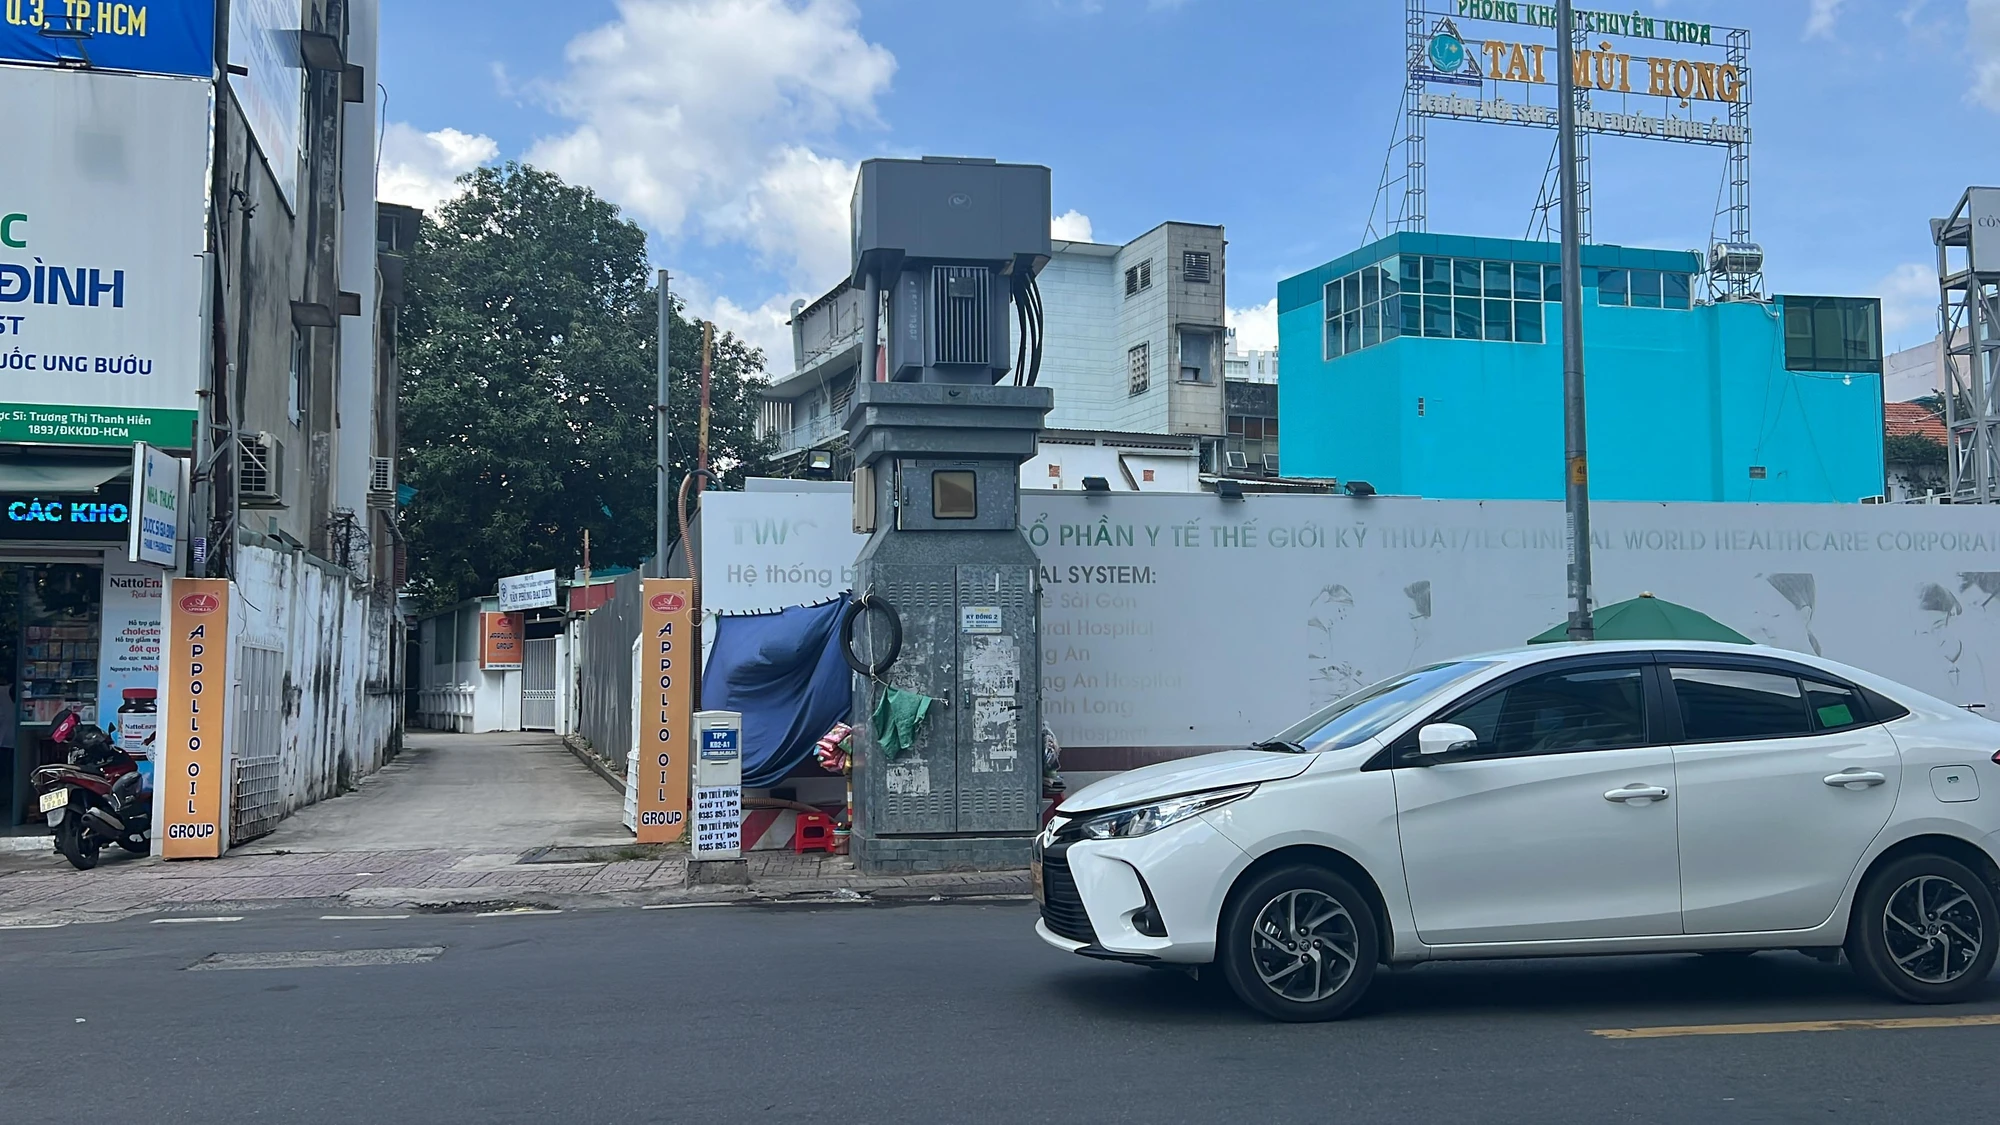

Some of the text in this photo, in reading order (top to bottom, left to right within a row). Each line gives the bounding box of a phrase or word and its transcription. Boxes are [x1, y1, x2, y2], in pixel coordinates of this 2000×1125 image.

[1585, 10, 1655, 39] CHUYÊN
[1664, 19, 1711, 45] KHOA
[1484, 40, 1739, 108] TAI MŨI HỌNG
[1420, 91, 1477, 116] KHÁM
[0, 213, 28, 249] C
[0, 256, 125, 308] ĐÌNH
[43, 354, 88, 373] UNG
[94, 353, 153, 375] BƯỚU
[29, 411, 68, 425] Trương
[90, 413, 125, 425] Thanh
[8, 497, 128, 523] CÁC KHO
[1028, 512, 1050, 547] Ổ
[1059, 514, 1135, 547] PHẦN
[1144, 525, 1161, 547] Y
[1170, 517, 1201, 548] TẾ
[1210, 517, 1259, 548] THẾ
[1267, 520, 1326, 549] GIỚI
[1334, 521, 1368, 548] KỸ
[1623, 529, 1707, 551] WORLD
[1714, 529, 1869, 552] HEALTHCARE
[1876, 529, 2000, 552] CORPORAT
[727, 564, 758, 588] Hệ
[766, 562, 833, 589] thống
[1040, 565, 1158, 584] AL SYSTEM:
[1064, 645, 1091, 661] An
[1041, 674, 1066, 692] ng
[1073, 671, 1099, 688] An
[168, 823, 215, 839] GROUP
[641, 811, 683, 826] GROUP
